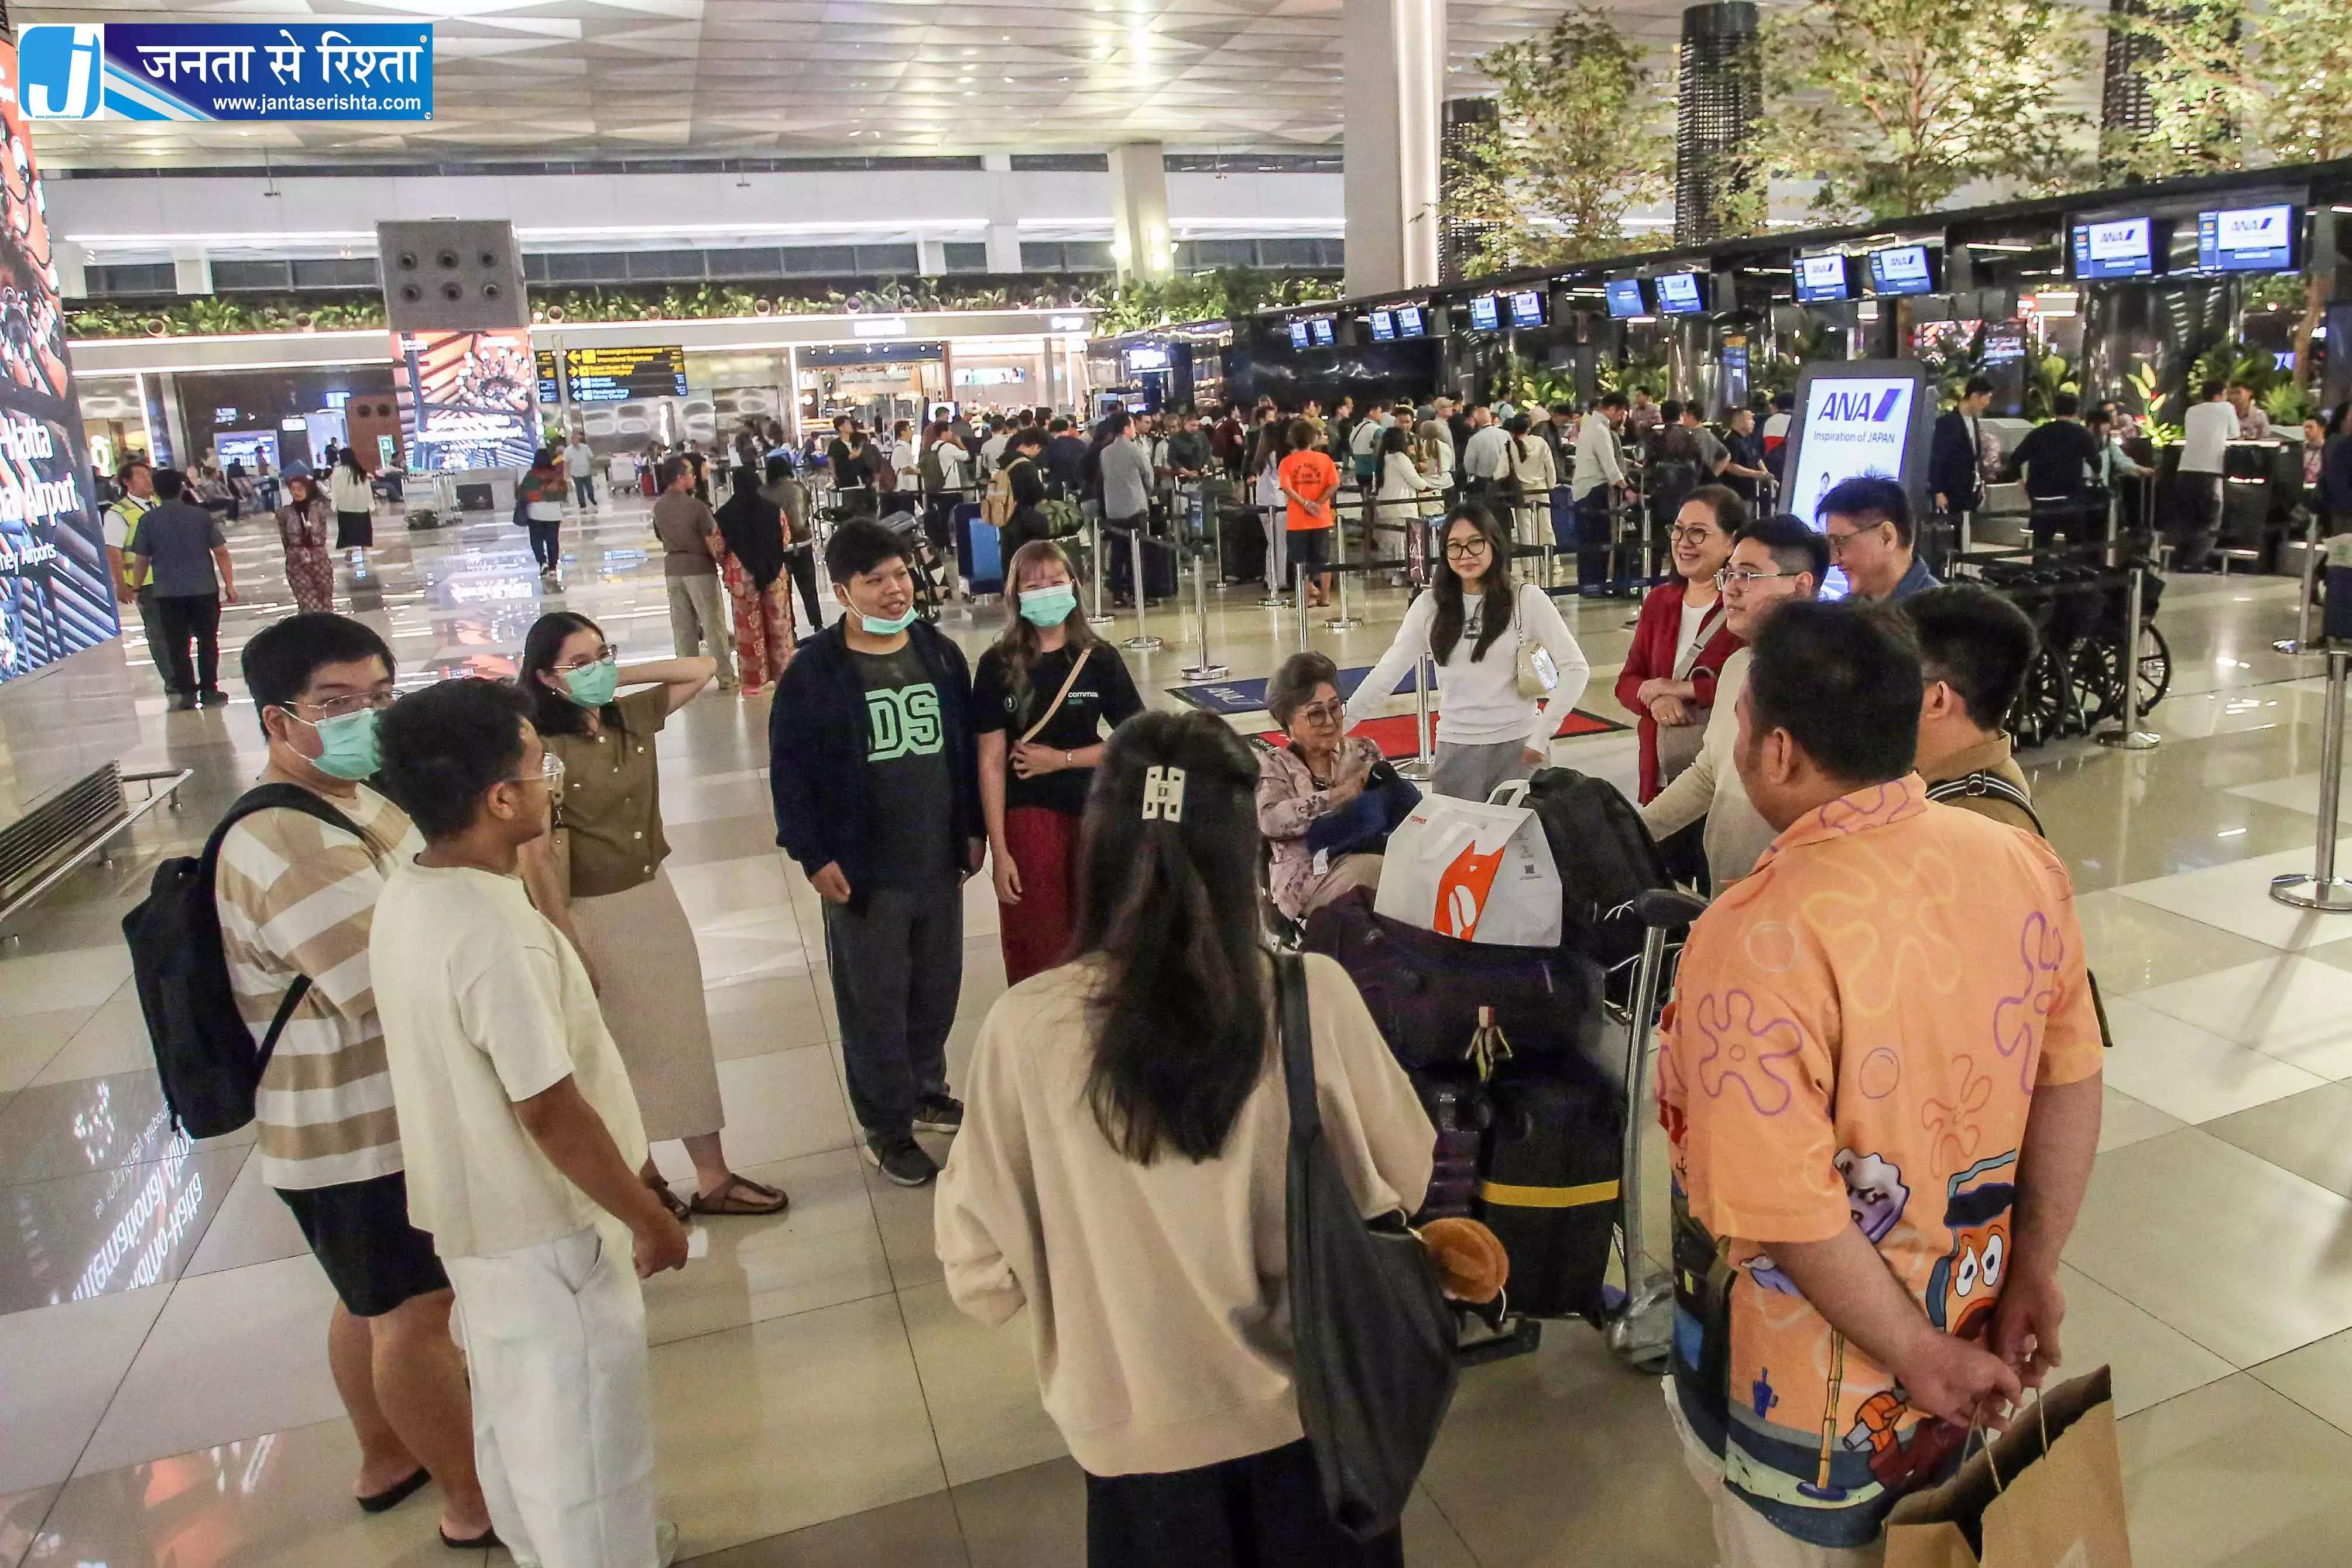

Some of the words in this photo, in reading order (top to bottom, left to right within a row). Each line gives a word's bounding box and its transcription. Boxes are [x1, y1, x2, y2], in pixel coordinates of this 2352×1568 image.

[1818, 392, 1871, 421] ANA
[1813, 431, 1856, 442] Inspiration
[1857, 431, 1867, 442] of
[1867, 432, 1895, 443] JAPAN
[23, 471, 80, 526] Airport
